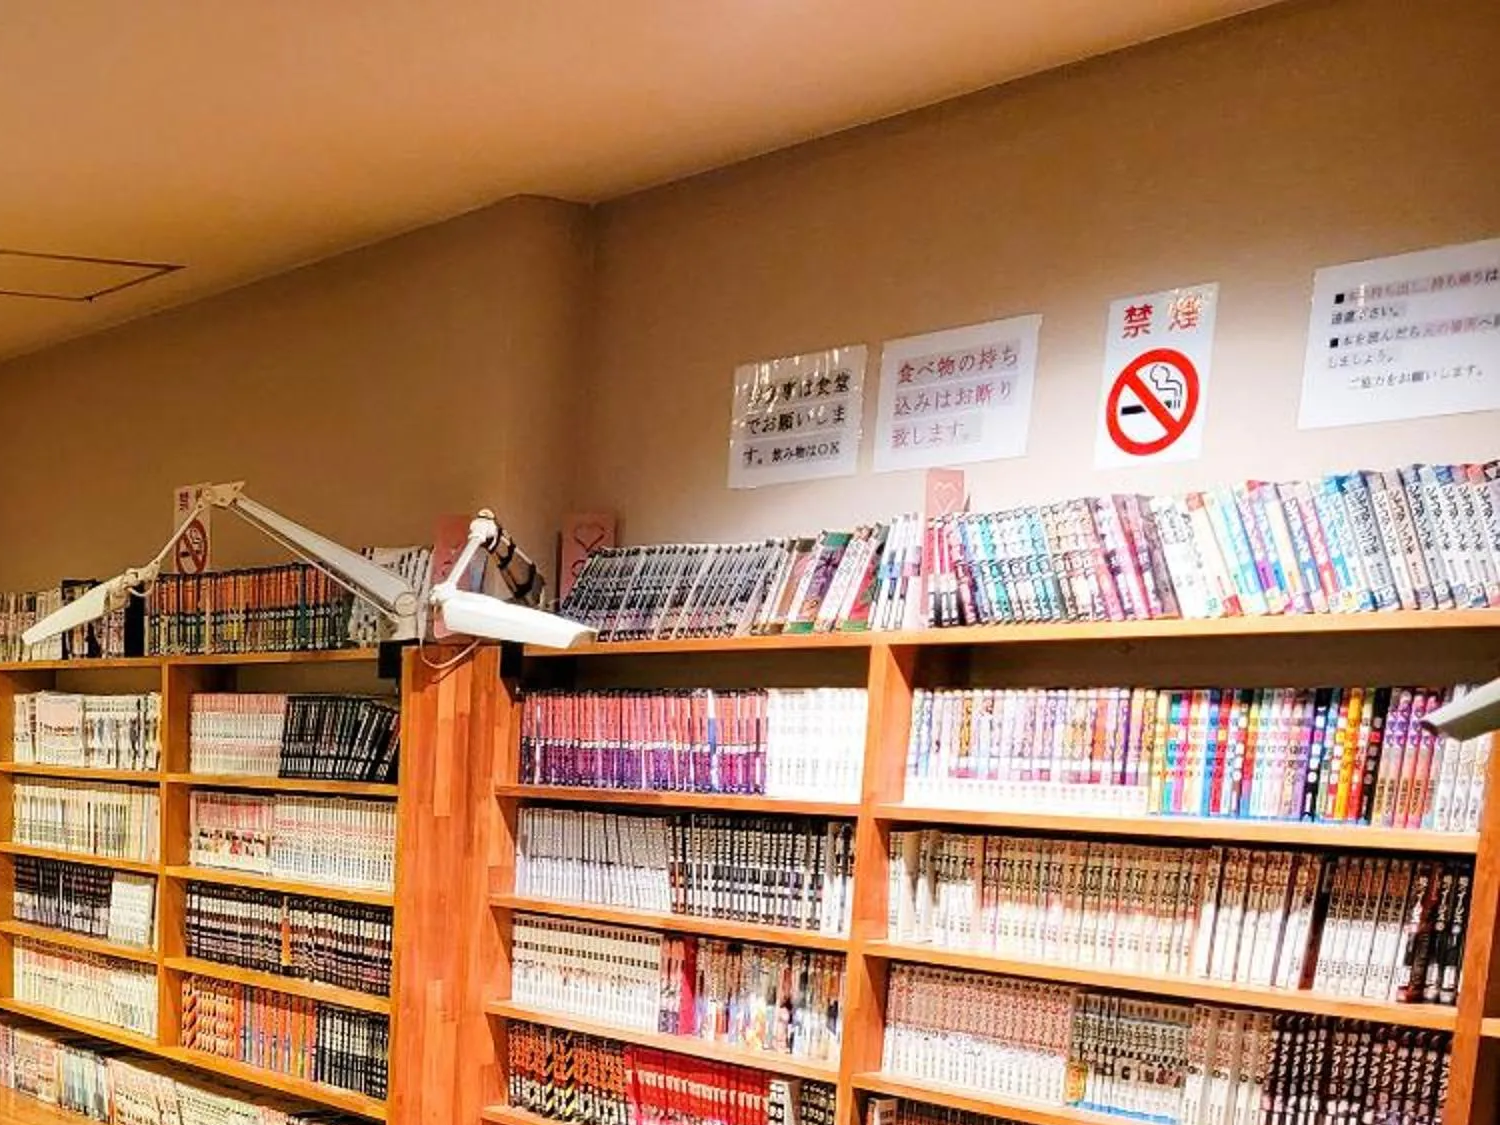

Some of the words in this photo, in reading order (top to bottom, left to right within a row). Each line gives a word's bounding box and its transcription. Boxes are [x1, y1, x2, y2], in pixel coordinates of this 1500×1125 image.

[1122, 295, 1204, 339] 禁煙
[898, 346, 1018, 385] 食べ物の持ち
[894, 381, 1011, 416] 込みはお断り
[891, 420, 970, 448] 致します。
